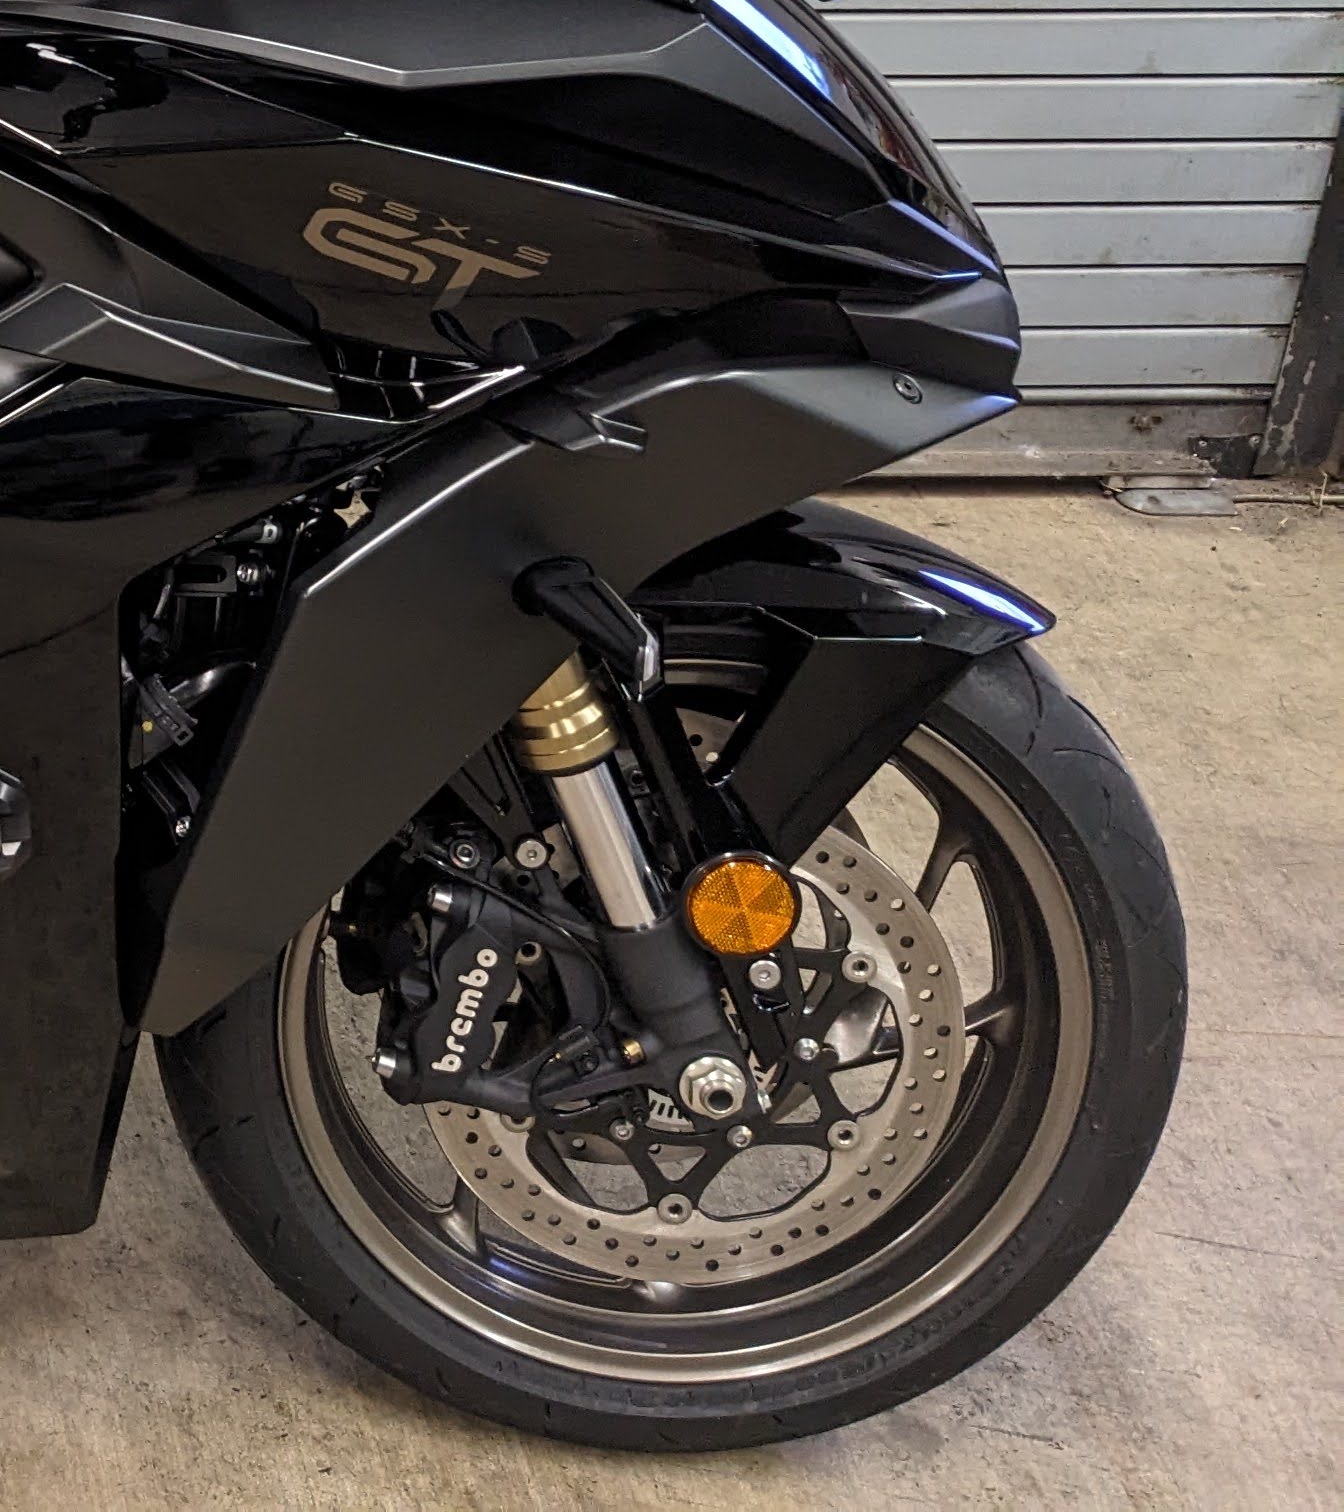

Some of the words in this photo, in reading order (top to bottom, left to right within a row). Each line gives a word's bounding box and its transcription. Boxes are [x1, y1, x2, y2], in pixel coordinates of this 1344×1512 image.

[303, 208, 541, 312] GT
[327, 182, 552, 265] GSX-S
[431, 948, 498, 1073] brembo
